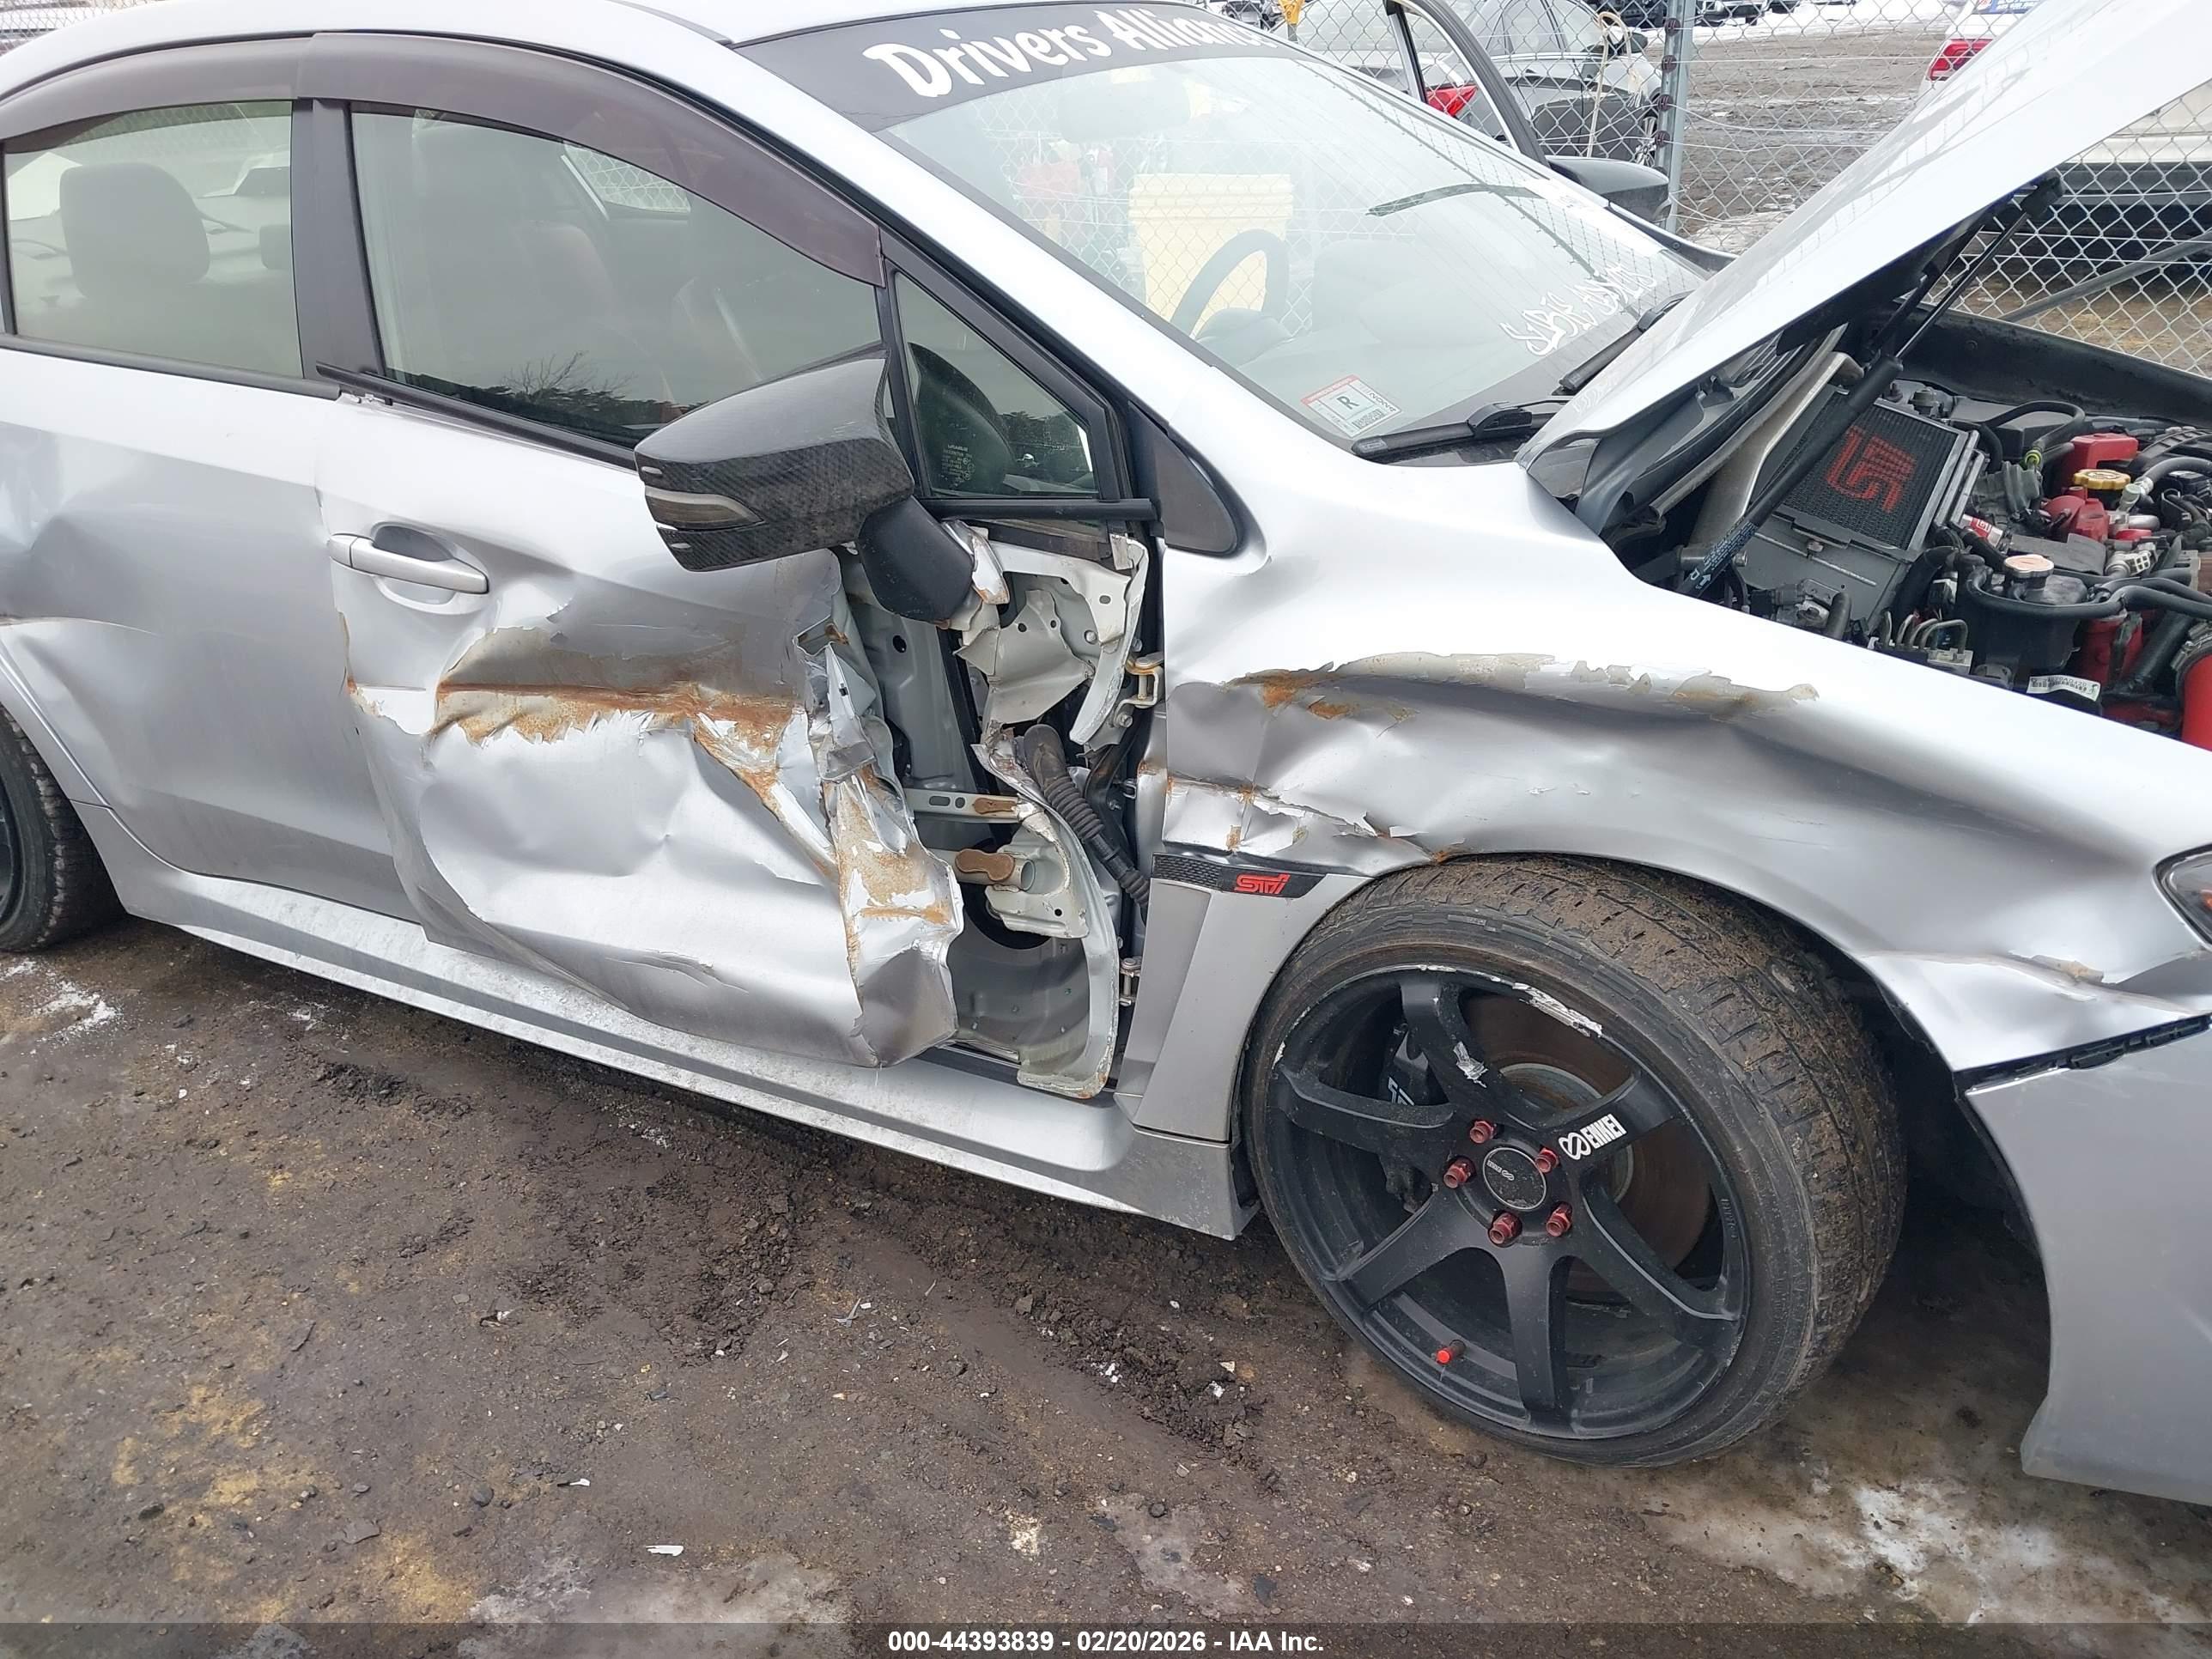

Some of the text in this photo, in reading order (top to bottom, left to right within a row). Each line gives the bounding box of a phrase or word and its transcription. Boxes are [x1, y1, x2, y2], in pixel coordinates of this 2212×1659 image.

[862, 8, 1279, 98] Drivers Alliance
[1336, 395, 1360, 410] R
[1580, 1114, 1627, 1149] ENKEI
